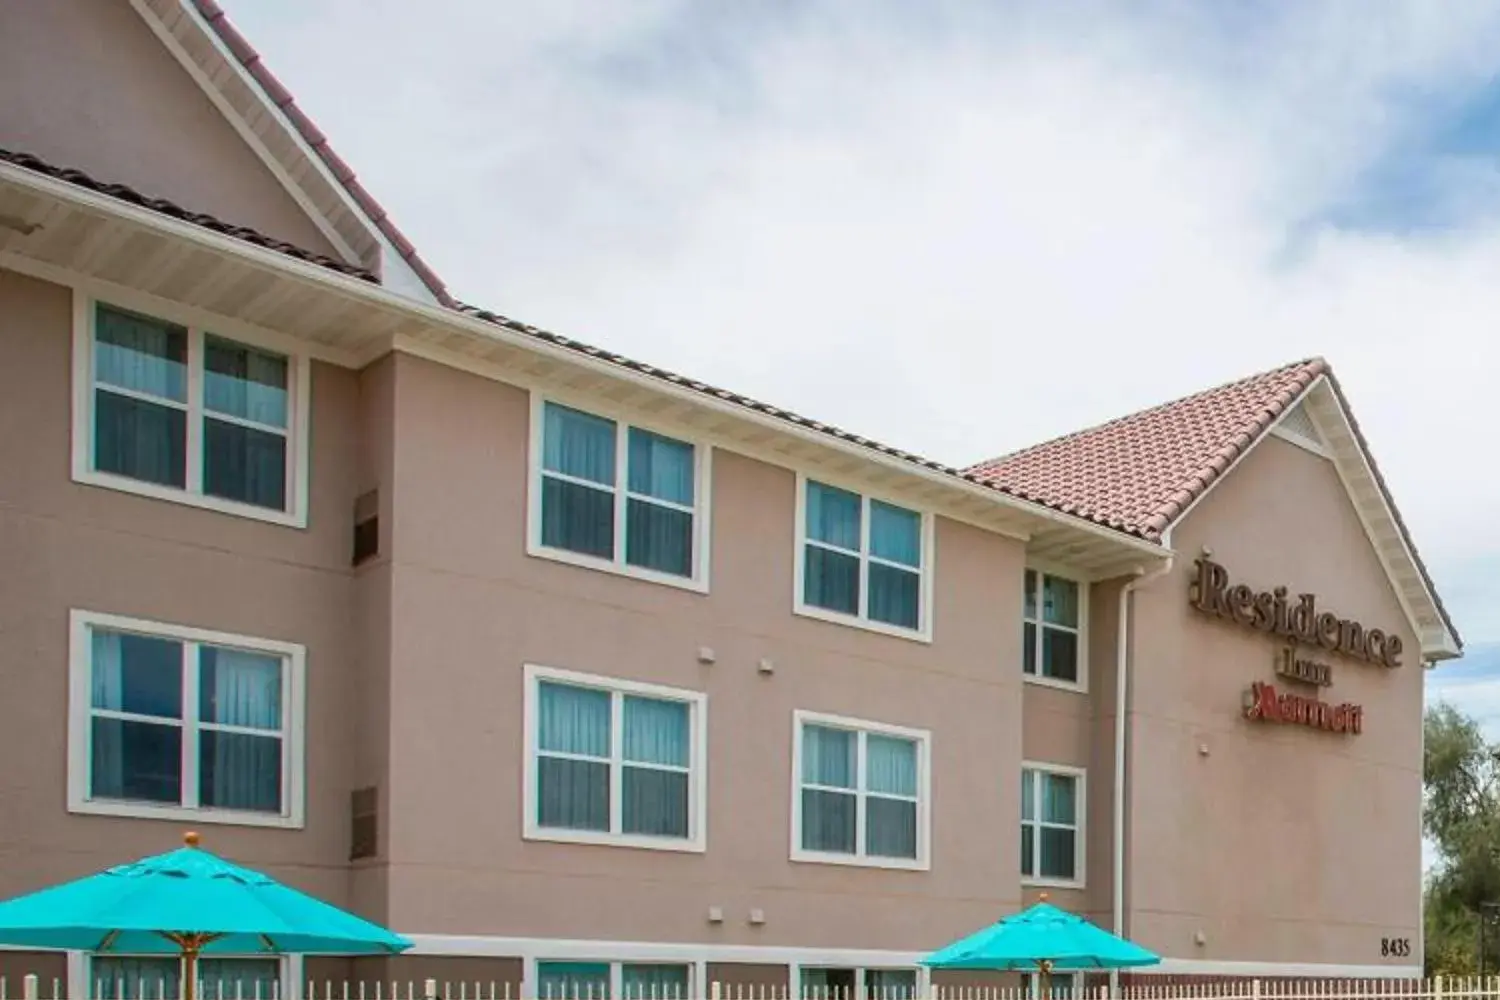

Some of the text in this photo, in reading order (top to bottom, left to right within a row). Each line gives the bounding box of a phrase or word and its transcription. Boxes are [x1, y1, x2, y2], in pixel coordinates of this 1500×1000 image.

[1190, 554, 1402, 668] Residence
[1244, 681, 1363, 735] Marriott
[1381, 937, 1411, 957] 8435
